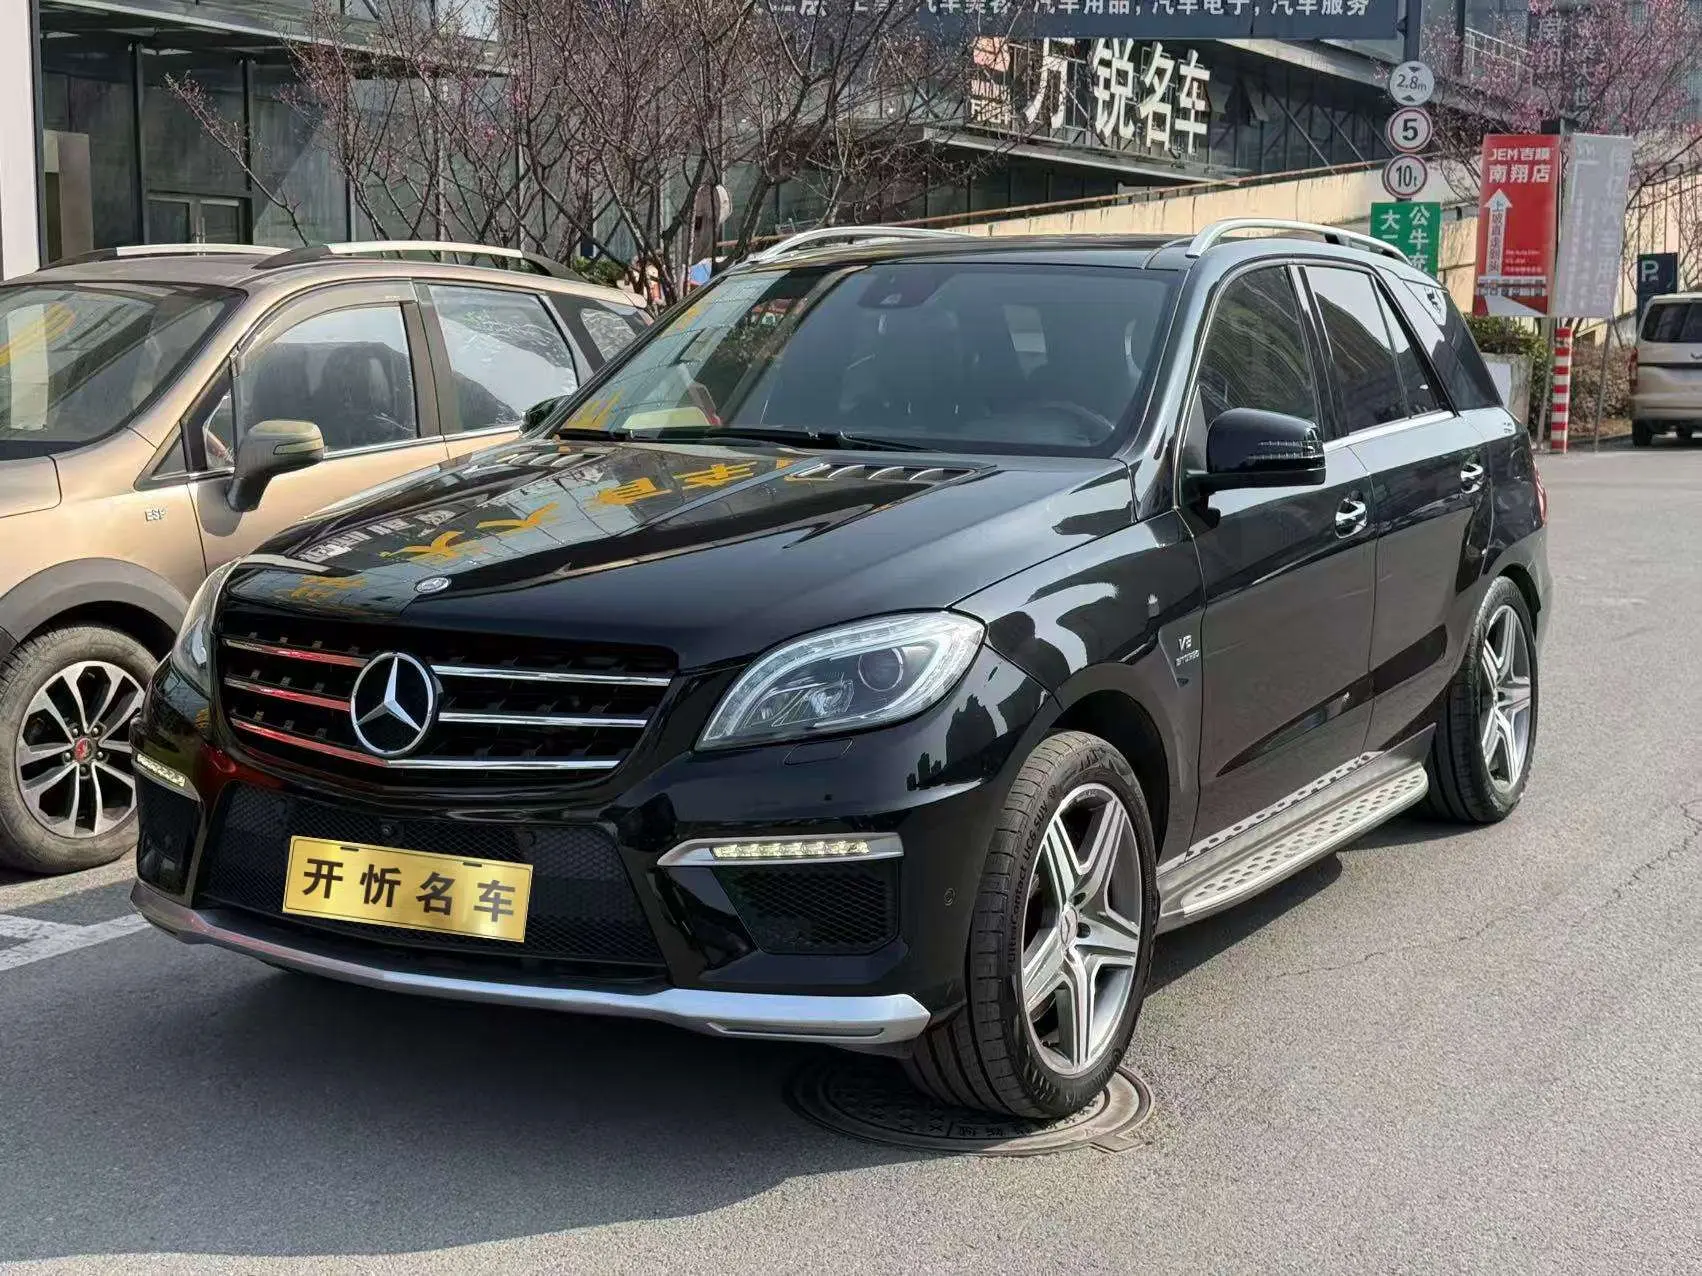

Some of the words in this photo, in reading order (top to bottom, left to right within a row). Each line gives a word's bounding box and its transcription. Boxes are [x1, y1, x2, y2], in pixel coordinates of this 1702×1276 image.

[1396, 73, 1427, 91] 2.8m
[1402, 118, 1419, 141] 5
[1396, 165, 1418, 187] 10t
[1488, 163, 1552, 183] 南翔店
[1641, 260, 1659, 282] P
[145, 508, 167, 522] ESP
[1178, 635, 1192, 651] V8
[1023, 829, 1037, 862] UC6
[1033, 800, 1049, 828] SUV
[302, 858, 516, 923] 开忻名车
